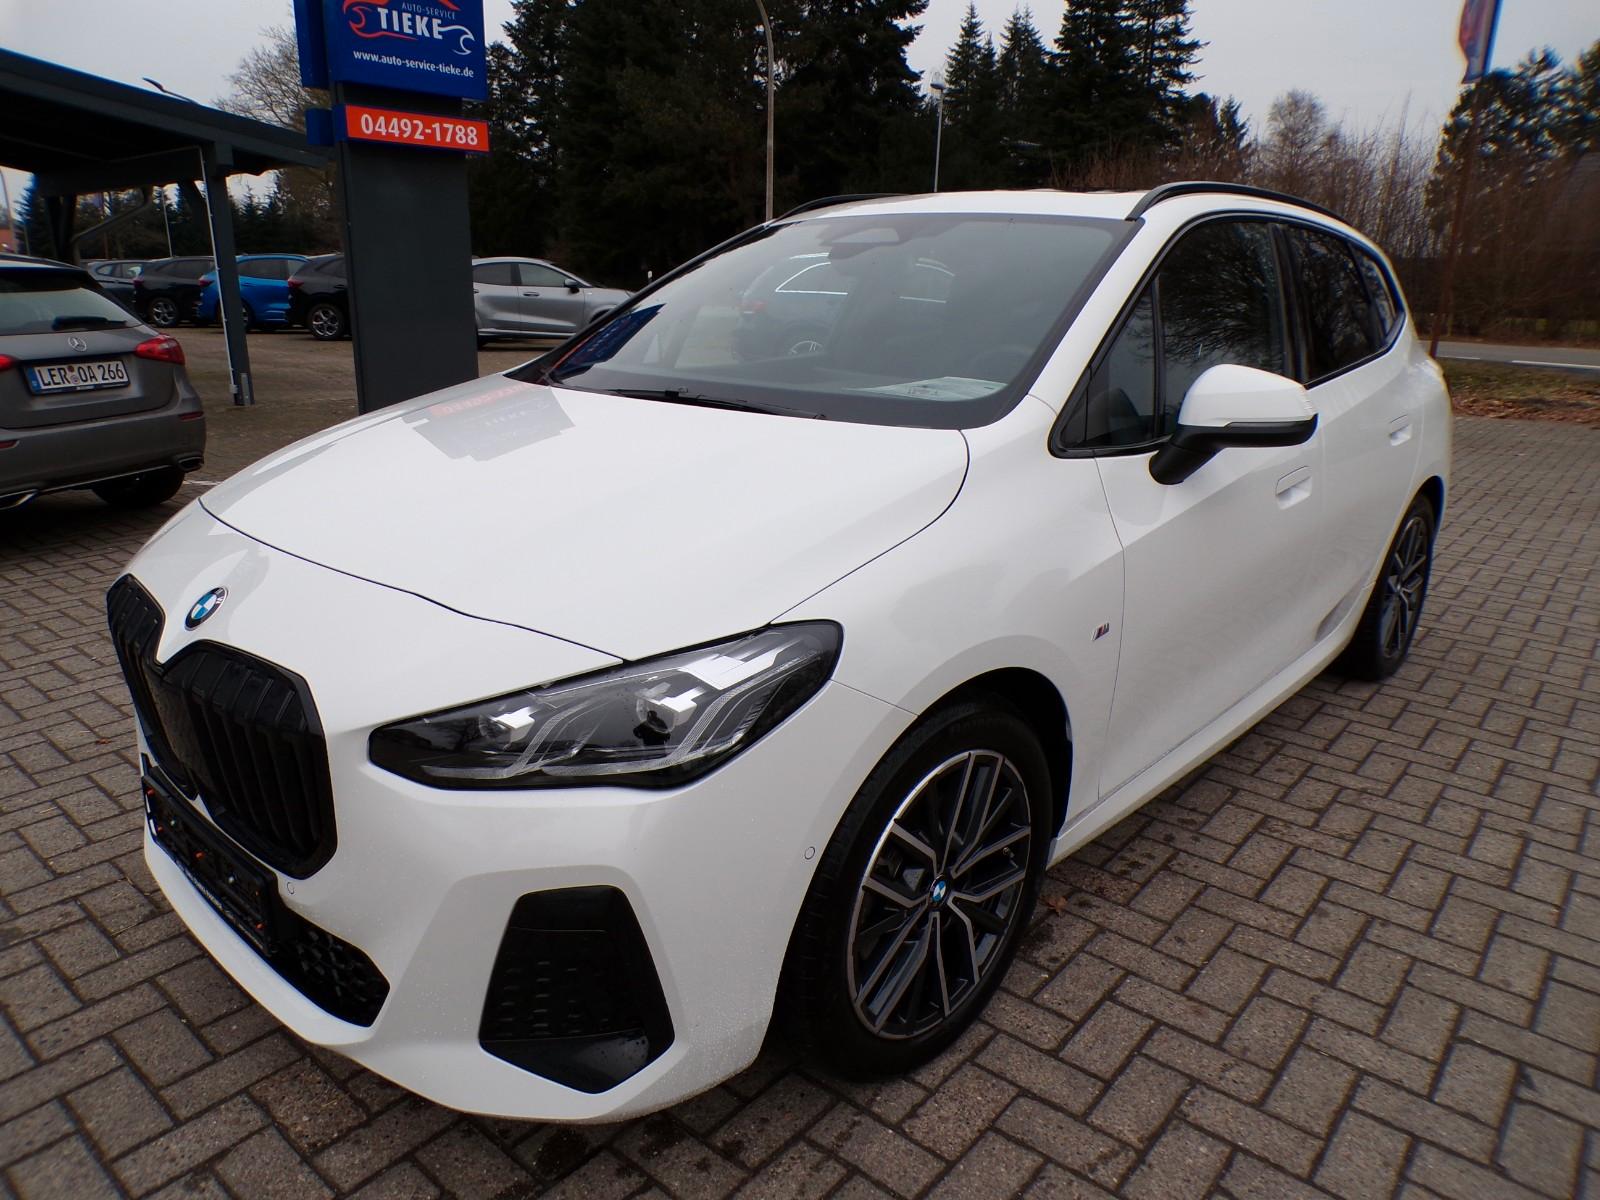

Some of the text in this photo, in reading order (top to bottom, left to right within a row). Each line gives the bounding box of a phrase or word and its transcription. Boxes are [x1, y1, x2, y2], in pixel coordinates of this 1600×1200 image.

[377, 7, 443, 39] TIEKE
[401, 3, 456, 20] AUTO-SERVICE
[353, 50, 474, 78] www.auto-service-tieke.de
[360, 114, 478, 146] 04492-1788
[37, 368, 70, 386] LER
[77, 365, 98, 383] OA
[98, 363, 124, 381] 266
